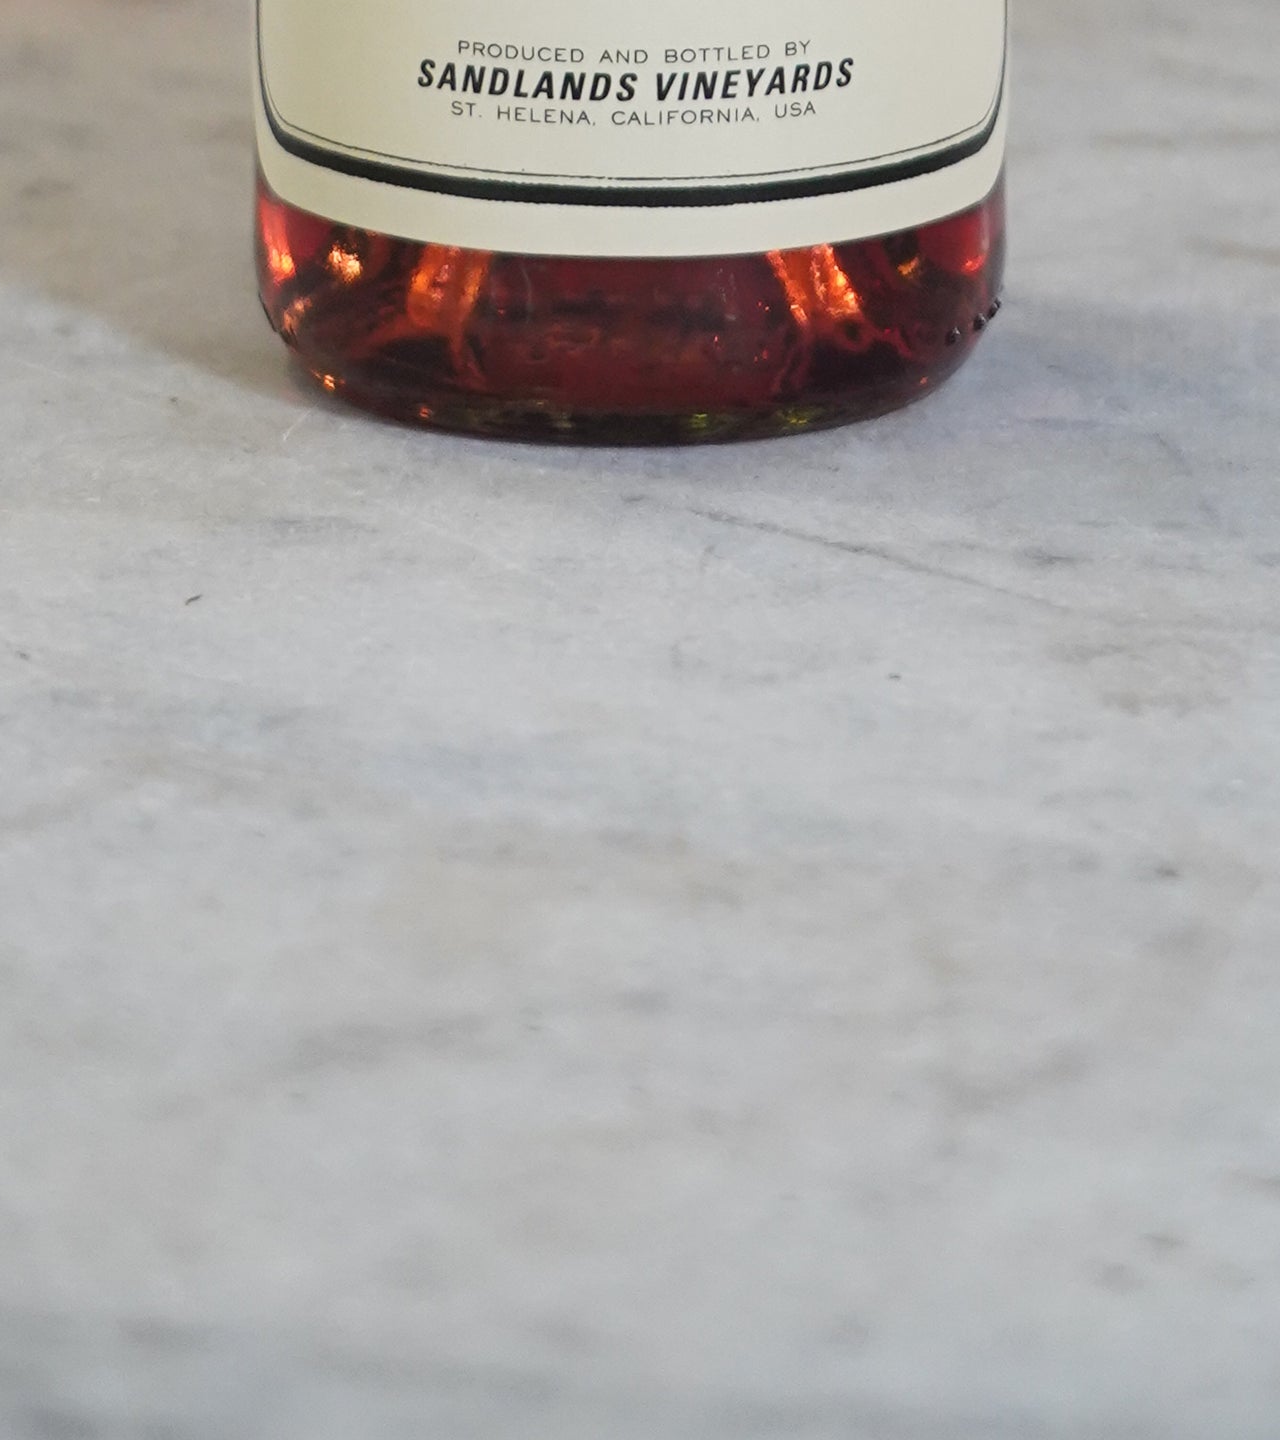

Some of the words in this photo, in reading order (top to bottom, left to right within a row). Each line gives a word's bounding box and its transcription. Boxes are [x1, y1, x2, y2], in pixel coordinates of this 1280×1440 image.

[456, 39, 586, 63] PRODUCED
[598, 49, 650, 64] AND
[663, 44, 772, 64] BOTTLED
[784, 39, 811, 57] BY
[416, 57, 639, 101] SANDLANDS
[654, 56, 855, 101] VINEYARDS
[450, 100, 483, 118] ST.
[497, 104, 596, 127] HELENA,
[610, 106, 760, 126] CALIFORNIA,
[774, 100, 817, 119] USA
